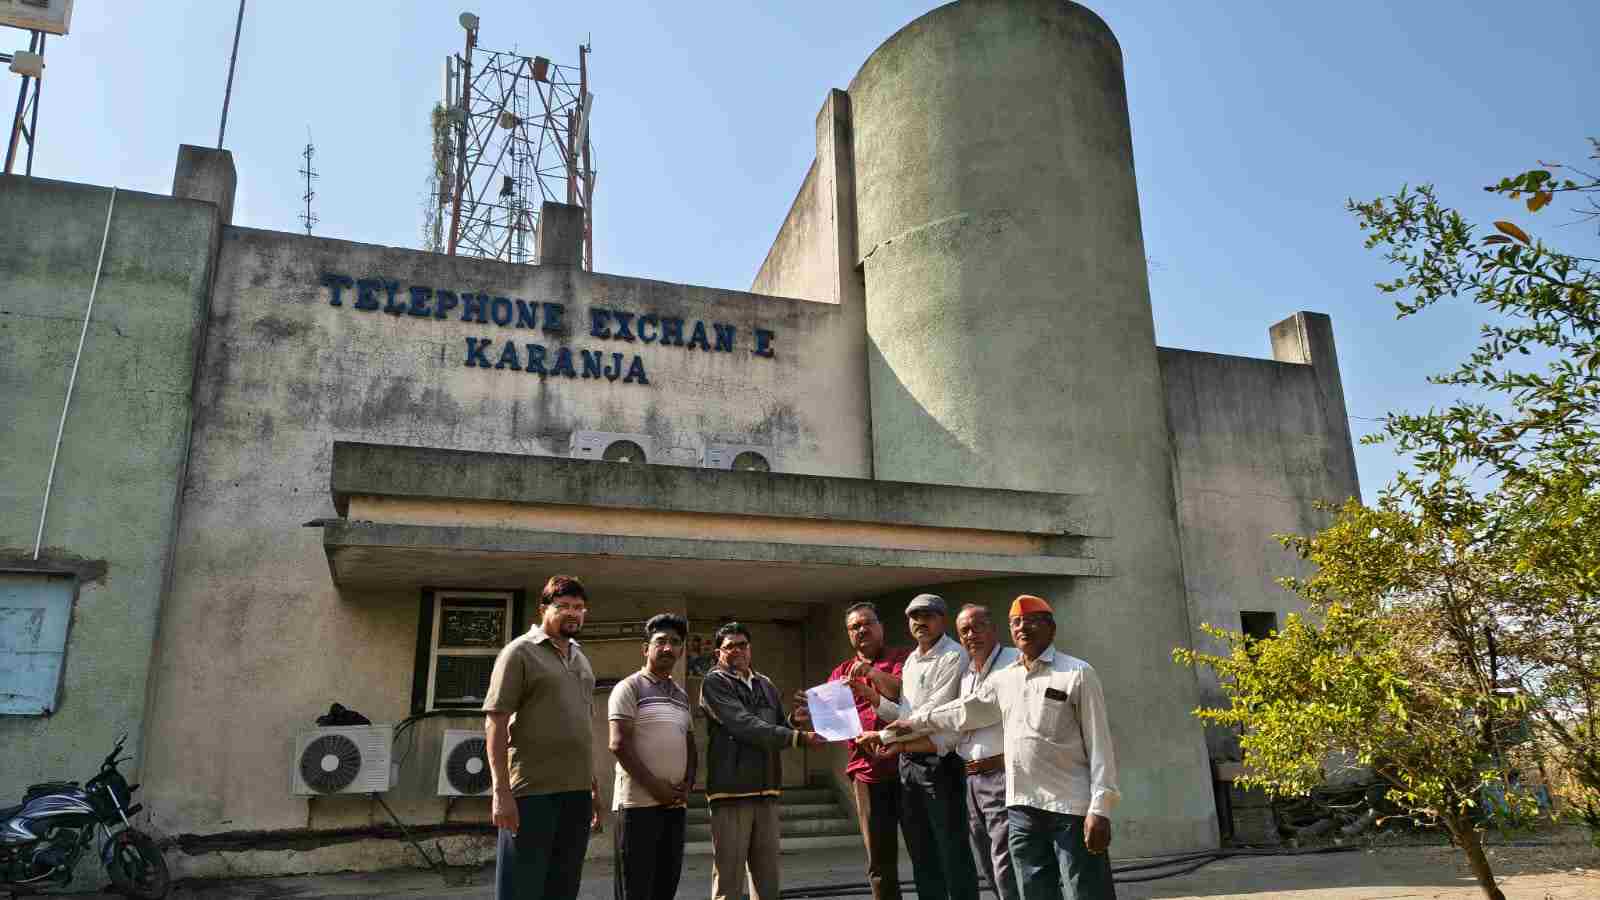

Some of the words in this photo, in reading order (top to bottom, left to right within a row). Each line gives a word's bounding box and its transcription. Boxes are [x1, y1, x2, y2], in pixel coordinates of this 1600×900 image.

[320, 273, 565, 332] TELEPHONE
[589, 308, 775, 358] EXCHANE
[464, 337, 649, 385] KARANJA
